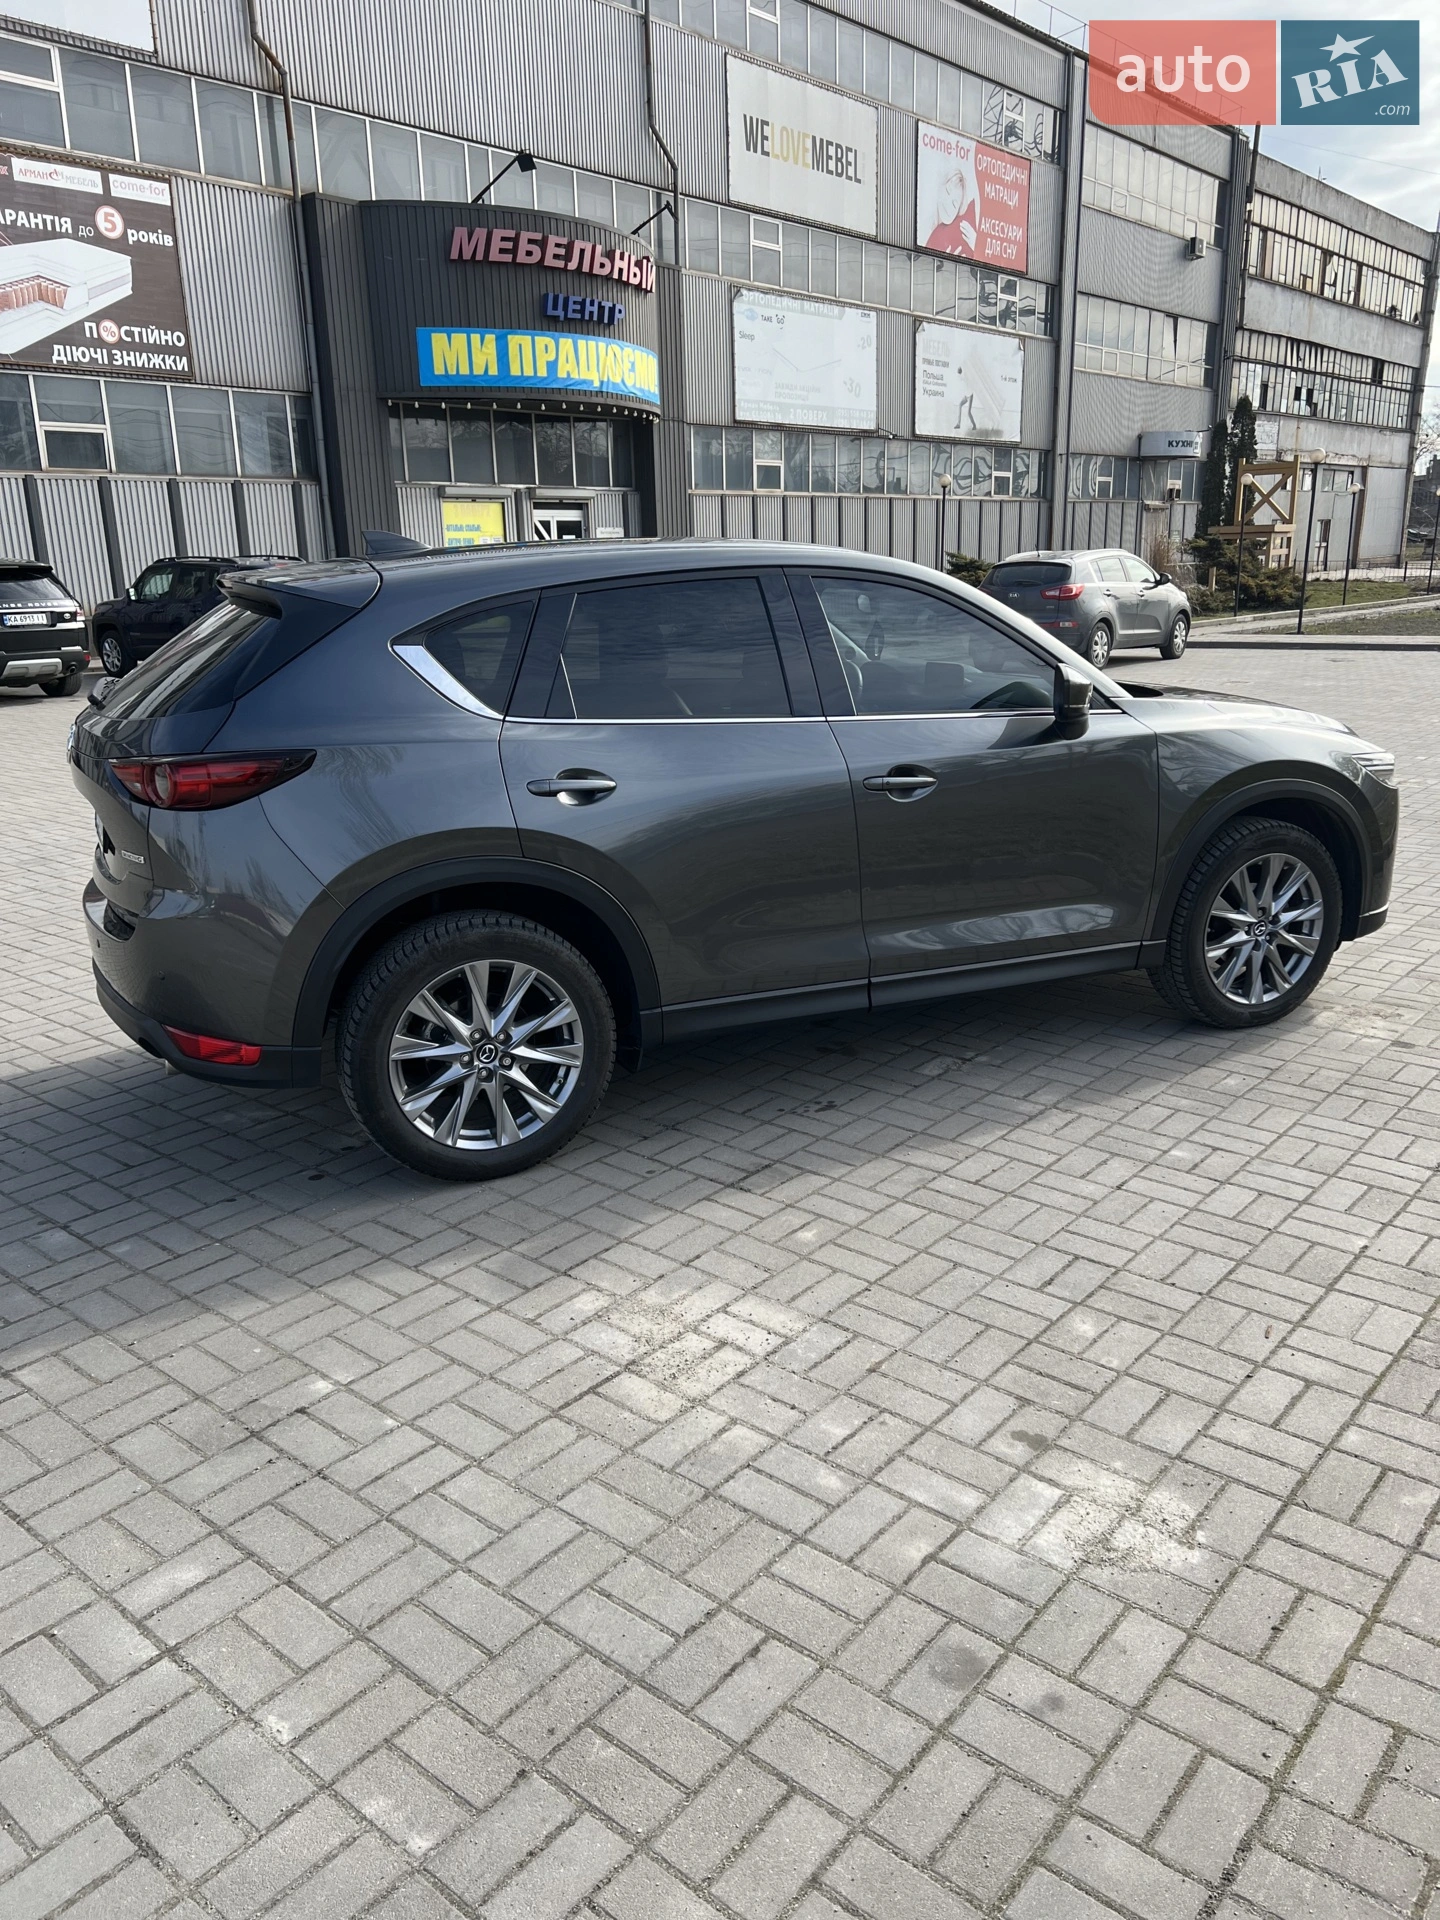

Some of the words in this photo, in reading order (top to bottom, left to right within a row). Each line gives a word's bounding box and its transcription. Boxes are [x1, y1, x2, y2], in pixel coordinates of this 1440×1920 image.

[65, 175, 99, 189] МЕБЕЛЬ
[977, 154, 1028, 186] ОРТОПЕДИЧНІ
[984, 181, 1019, 210] МАТРАЦИ
[103, 212, 117, 233] 5
[127, 228, 174, 247] років
[980, 216, 1023, 242] АКСЕСУАРИ
[450, 226, 656, 294] МЕБЕЛЬНЫЙ
[985, 238, 1001, 258] ДЛЯ
[1002, 240, 1018, 260] СНУ
[543, 292, 626, 327] ЦЕНТР
[761, 314, 773, 323] TAKE
[804, 301, 839, 316] МАТРАЦИ
[738, 330, 755, 342] Sleep
[52, 344, 109, 366] ДІЮЧІ
[112, 348, 189, 373] ЗНИЖКИ
[430, 332, 498, 376] МИ
[922, 369, 944, 381] Польша
[922, 386, 945, 398] Украина
[790, 410, 795, 418] 2
[796, 410, 828, 421] ПОВЕРХ
